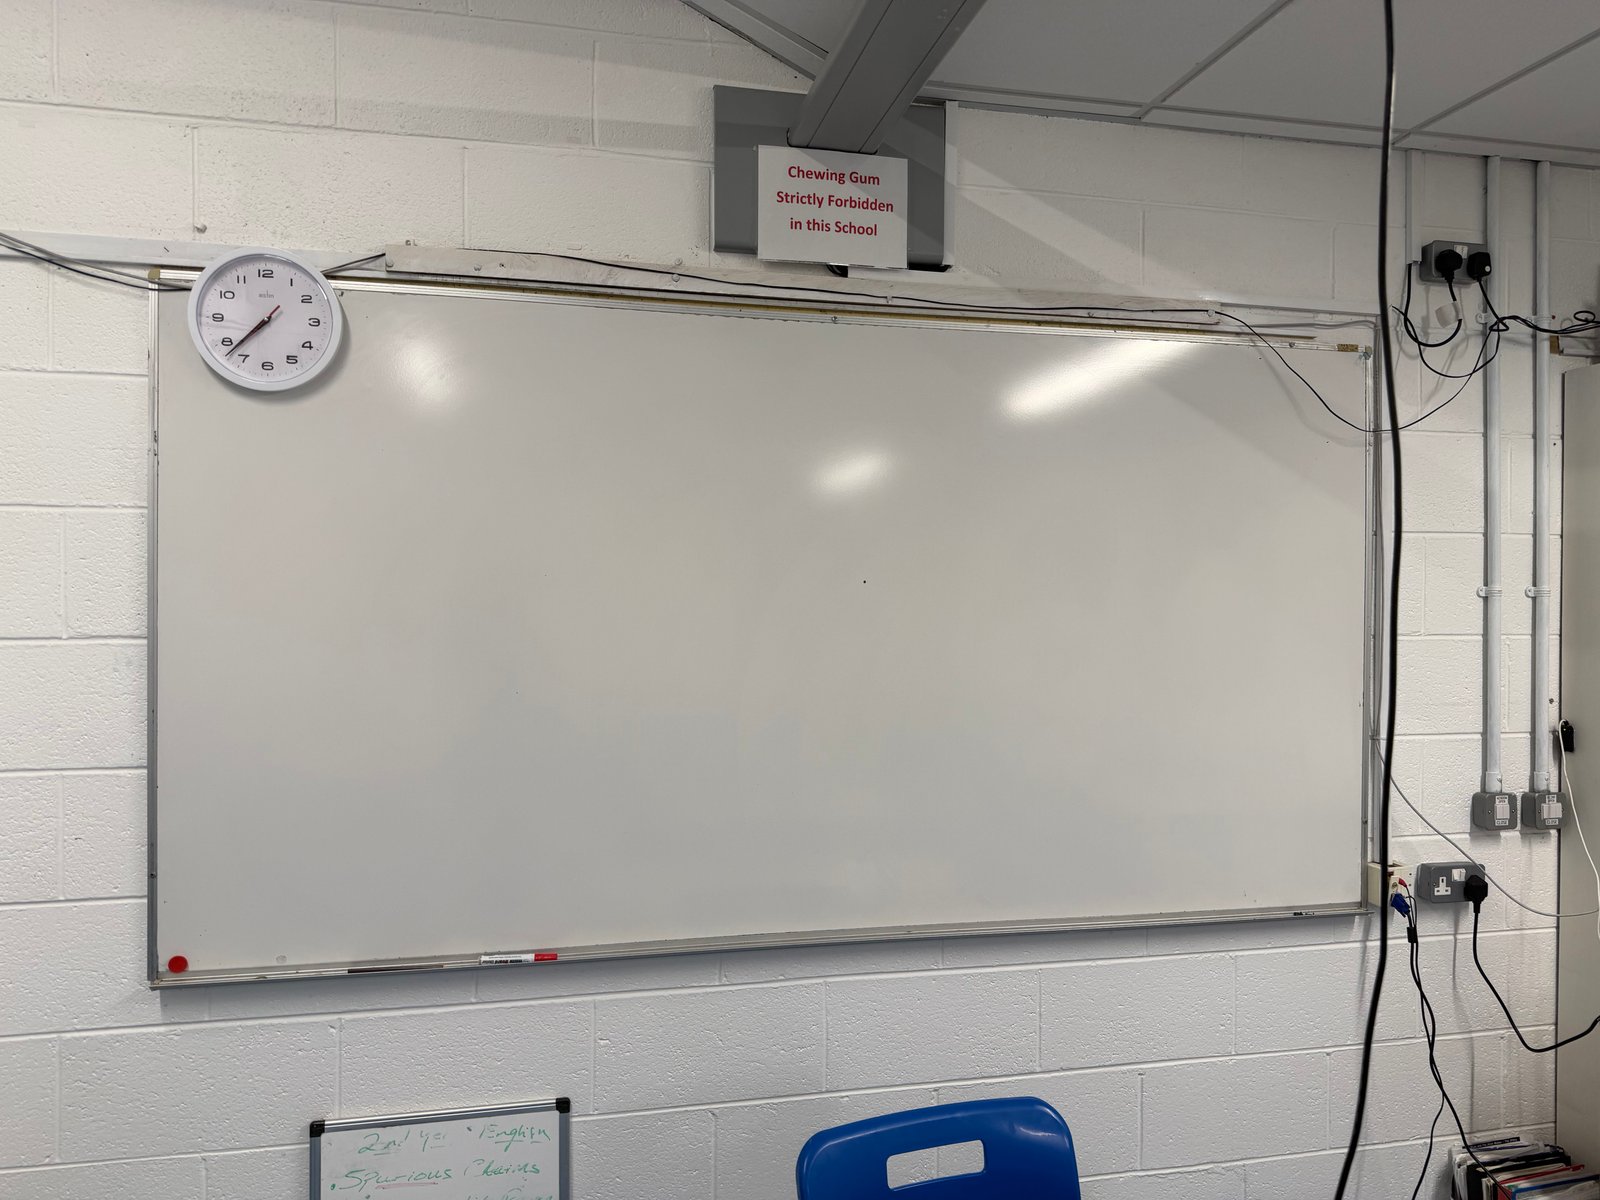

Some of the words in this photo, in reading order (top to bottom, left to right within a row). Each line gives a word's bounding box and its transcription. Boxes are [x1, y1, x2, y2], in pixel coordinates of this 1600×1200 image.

[787, 166, 846, 185] Chewing
[849, 171, 880, 186] Gum
[776, 191, 824, 208] Strictly
[828, 195, 894, 212] Forbidden
[790, 218, 802, 230] in
[806, 219, 831, 232] this
[835, 221, 878, 236] School
[257, 269, 274, 278] 12
[236, 275, 246, 284] 11
[290, 278, 294, 287] 1
[219, 290, 235, 299] 10
[300, 295, 313, 303] 2
[212, 313, 225, 322] 9
[308, 318, 321, 327] 3
[221, 337, 234, 347] 8
[301, 341, 314, 350] 4
[237, 353, 250, 363] 7
[286, 355, 298, 364] 5
[261, 361, 274, 371] 6
